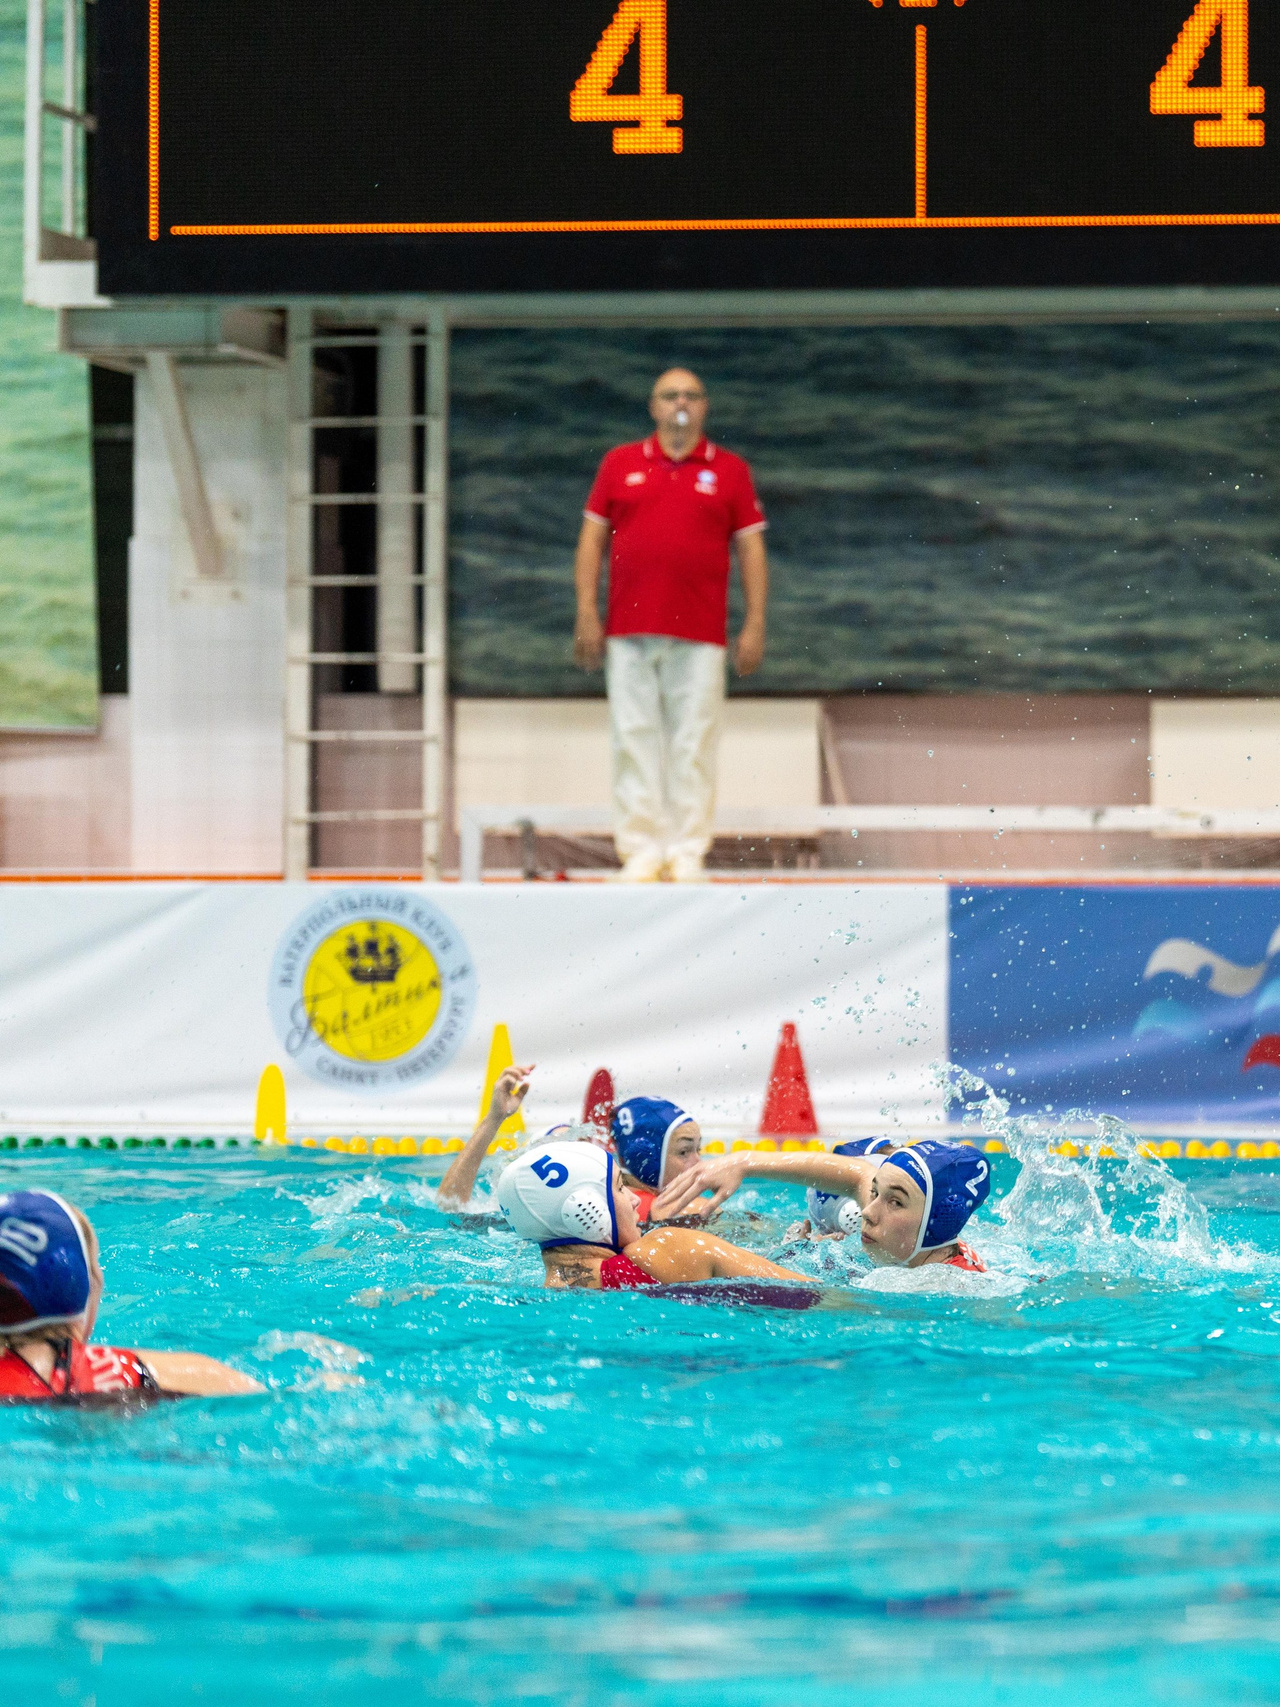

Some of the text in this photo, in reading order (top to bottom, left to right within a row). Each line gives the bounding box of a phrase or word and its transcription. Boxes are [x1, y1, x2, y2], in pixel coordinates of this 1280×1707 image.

[569, 0, 683, 154] 4
[1150, 0, 1265, 147] 4
[618, 1107, 635, 1136] 9
[530, 1155, 569, 1188] 5
[965, 1160, 989, 1197] 2
[0, 1217, 48, 1267] 10
